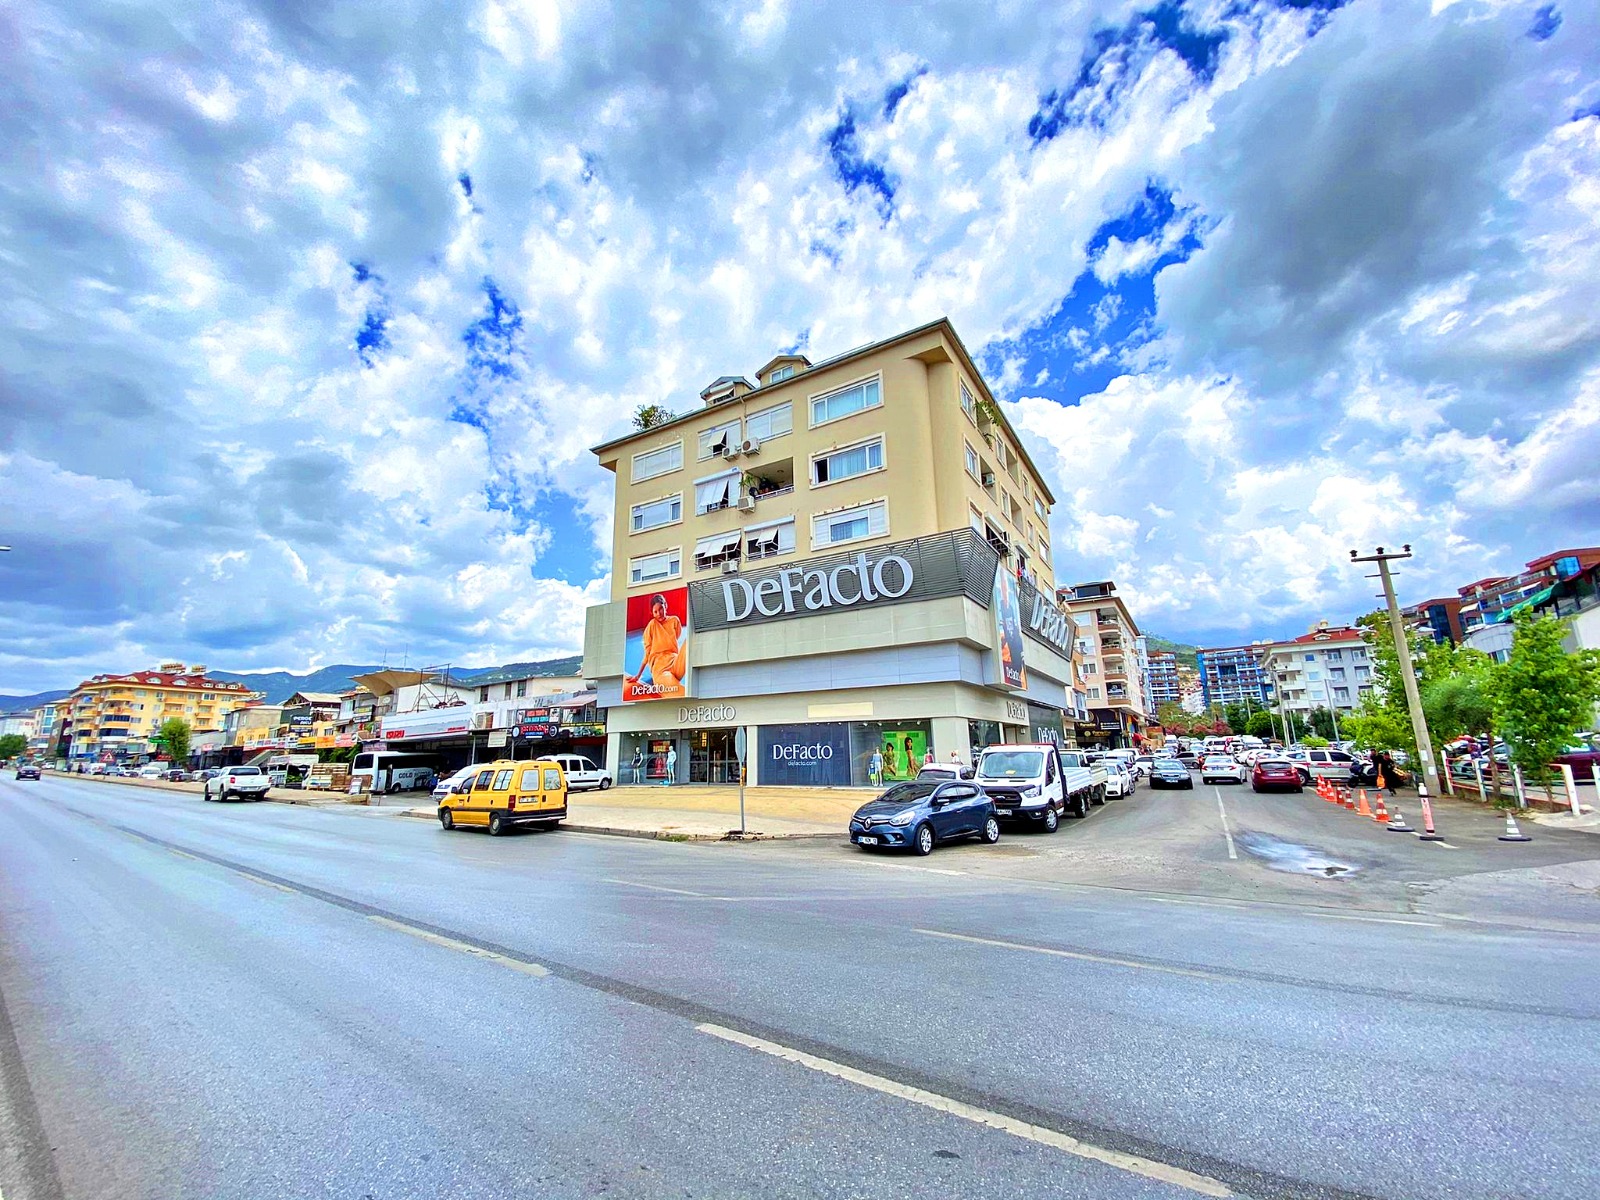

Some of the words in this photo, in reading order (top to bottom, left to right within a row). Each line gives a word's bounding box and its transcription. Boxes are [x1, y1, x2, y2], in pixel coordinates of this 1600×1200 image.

[721, 552, 914, 622] DeFacto
[1030, 592, 1069, 651] DeFacto
[631, 683, 679, 696] DeFacto.com
[678, 703, 737, 723] DeFacto
[772, 743, 833, 760] DeFacto
